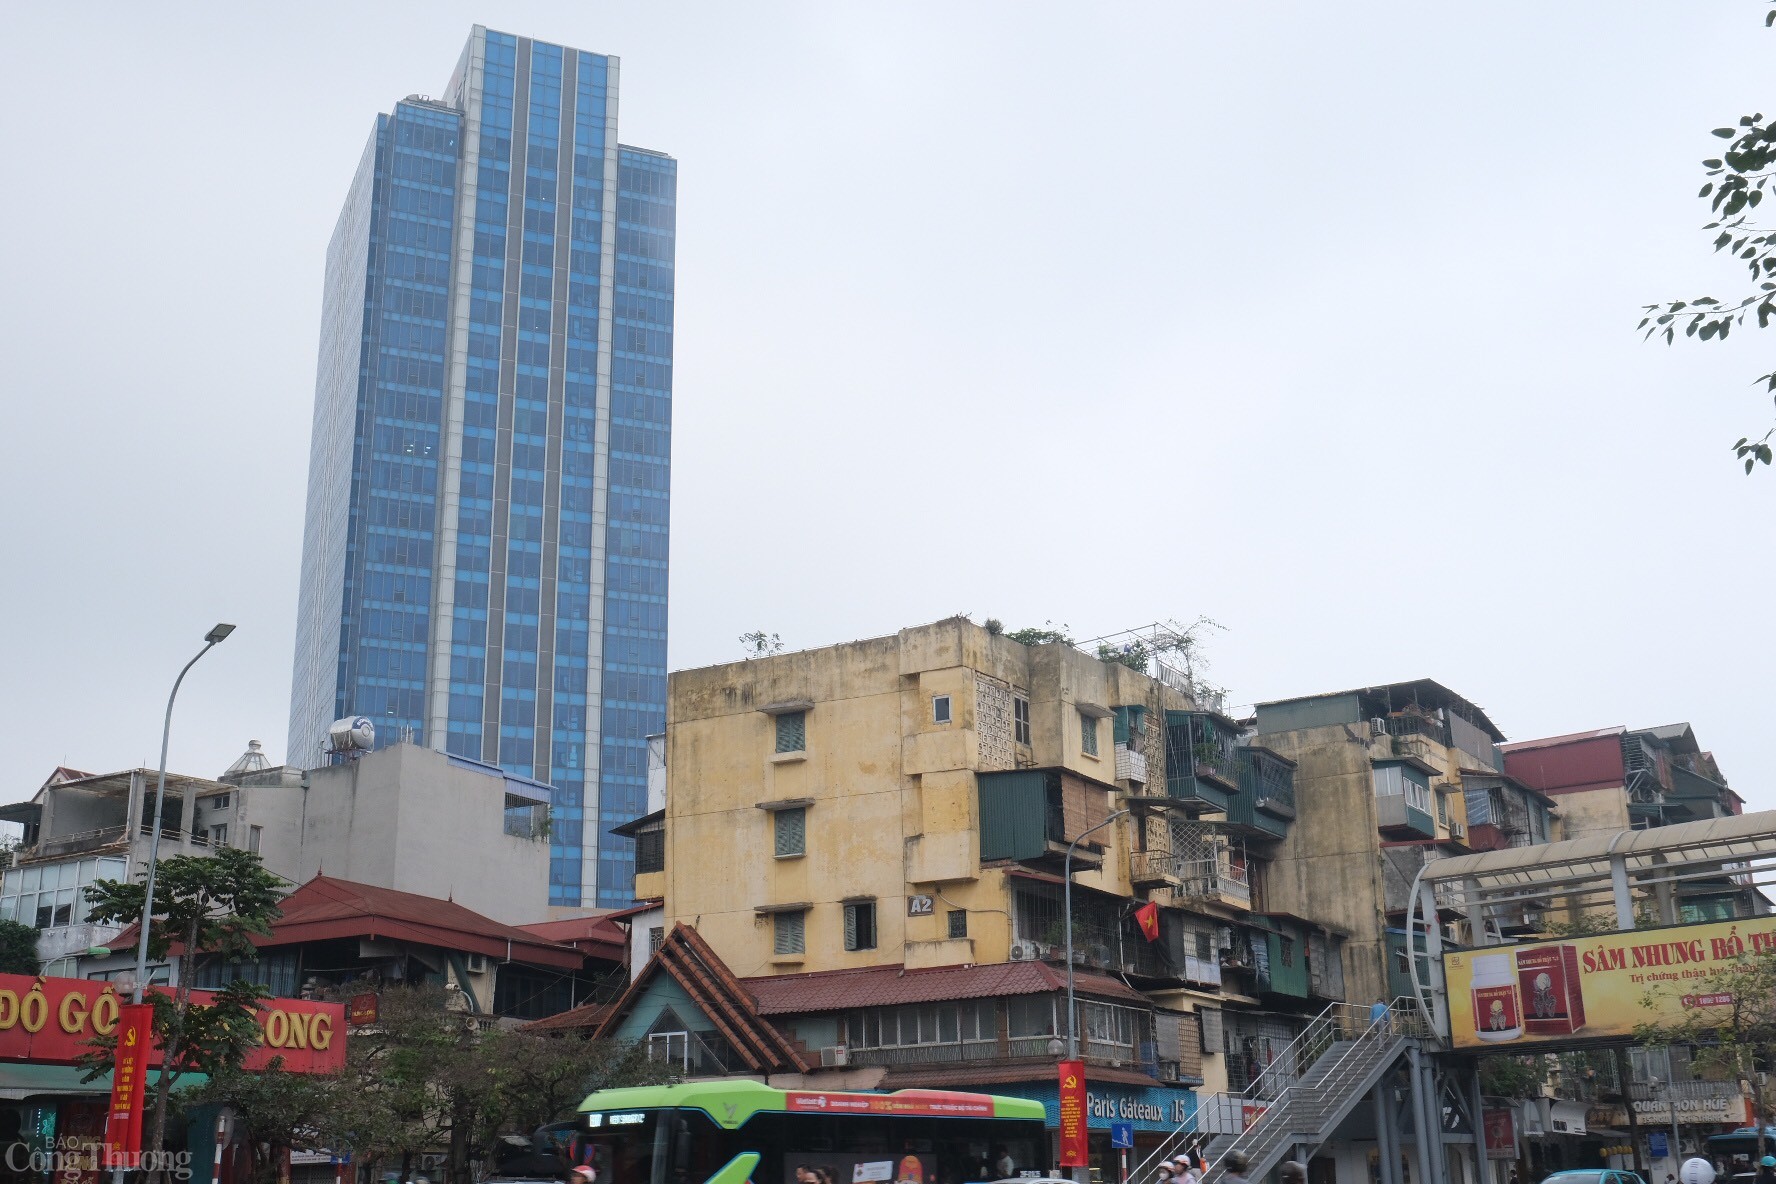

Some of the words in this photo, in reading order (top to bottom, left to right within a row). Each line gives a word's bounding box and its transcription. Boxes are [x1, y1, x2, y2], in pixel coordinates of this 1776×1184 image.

[911, 899, 932, 912] A2
[1582, 944, 1627, 974] SÂM
[1630, 938, 1706, 968] NHUNG
[1710, 925, 1744, 960] BỔ
[1629, 974, 1644, 984] Trị
[1086, 1092, 1116, 1118] Paris
[1174, 1099, 1185, 1122] 15
